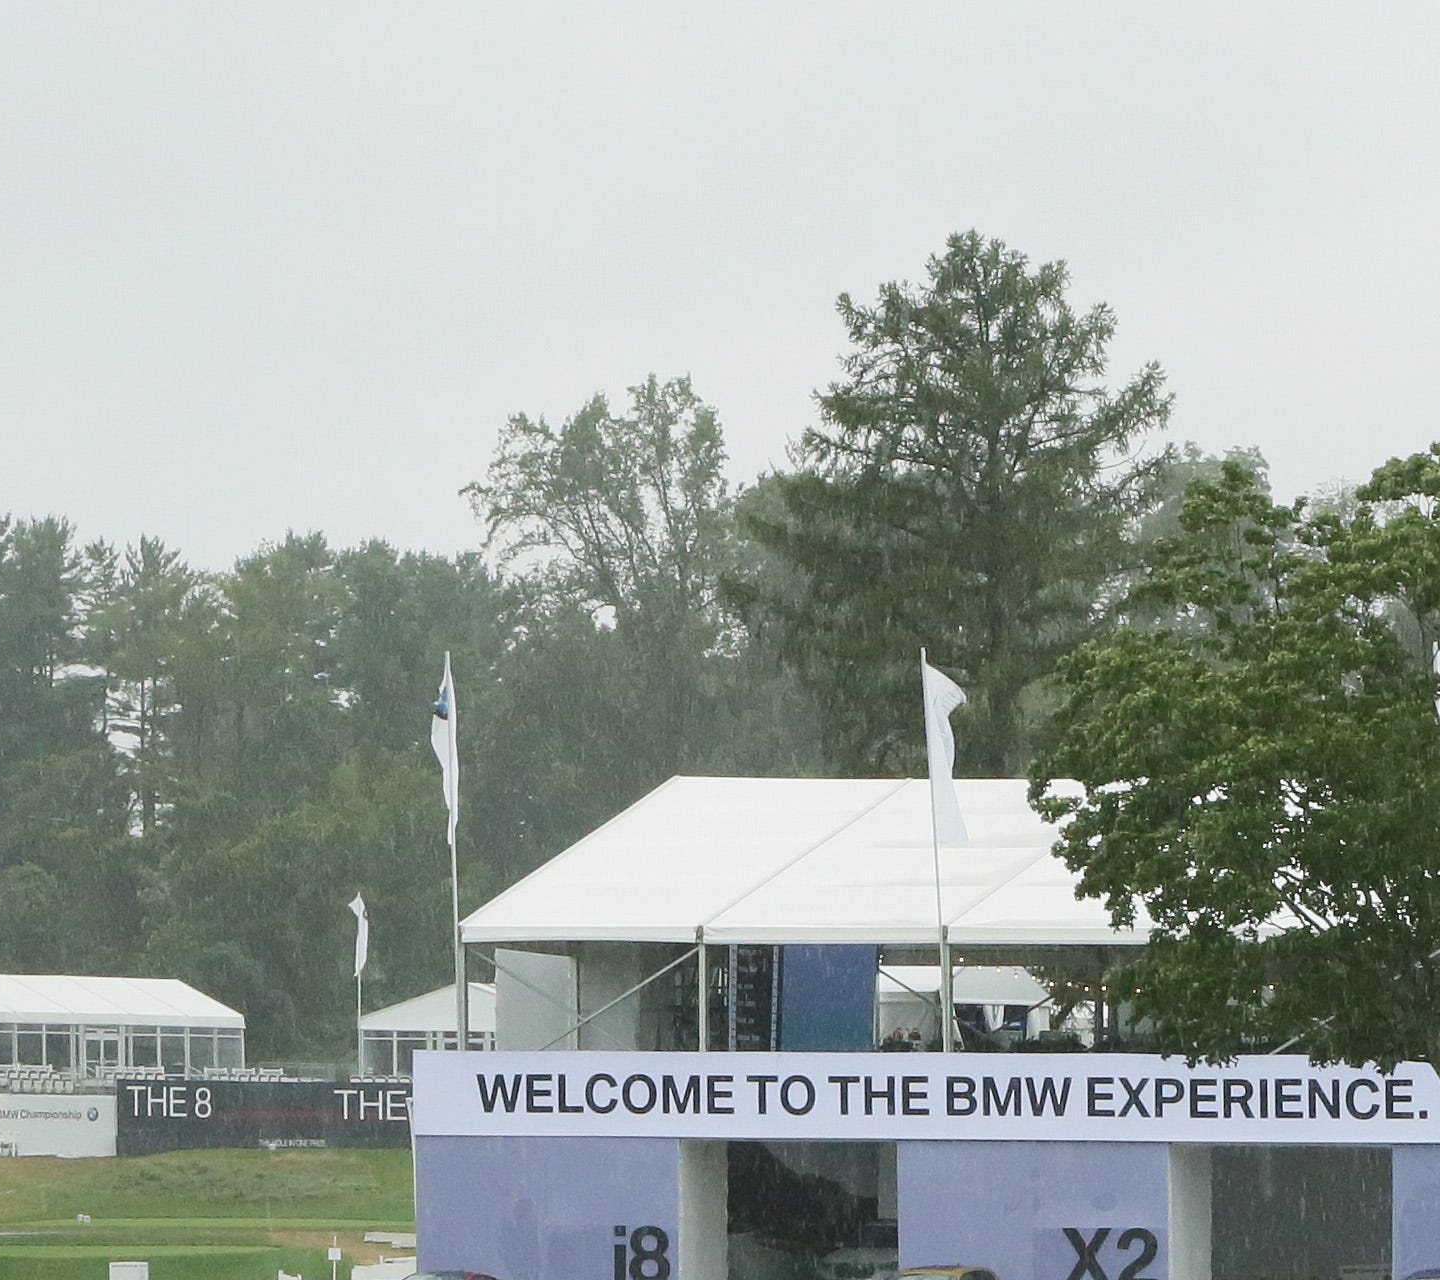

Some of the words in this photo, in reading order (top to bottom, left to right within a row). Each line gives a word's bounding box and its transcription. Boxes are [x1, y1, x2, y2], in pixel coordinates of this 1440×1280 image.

[126, 1085, 187, 1118] THE
[194, 1087, 212, 1118] 8
[334, 1089, 407, 1121] THE
[476, 1073, 735, 1115] WELCOME
[746, 1074, 816, 1116] TO
[827, 1075, 930, 1117] THE
[945, 1076, 1072, 1118] BMW
[1087, 1077, 1428, 1120] EXPERIENCE.
[19, 1109, 83, 1121] Championship
